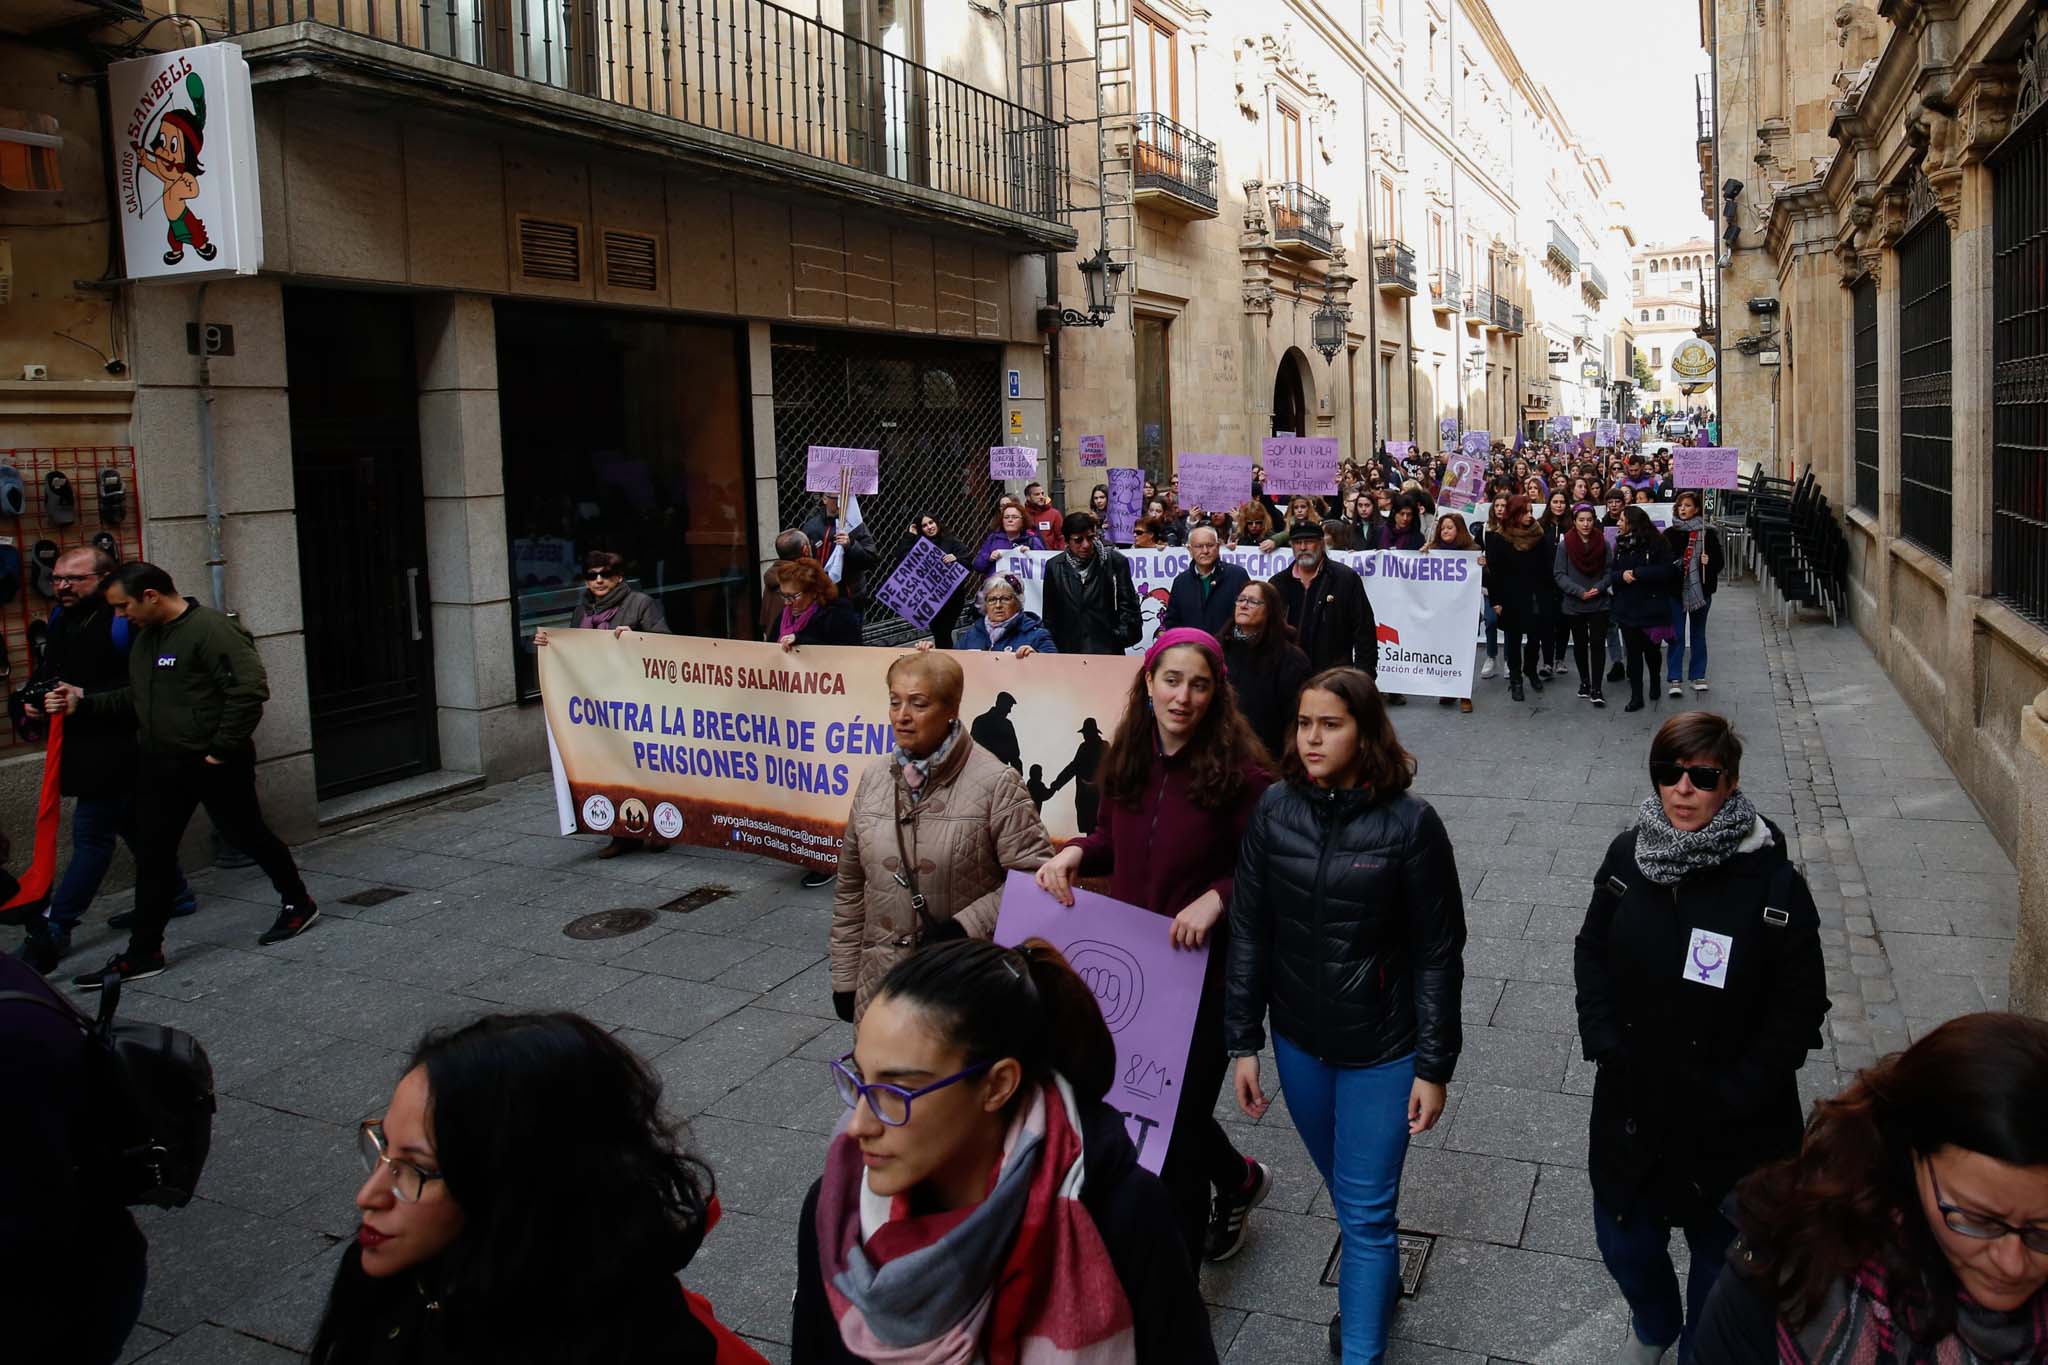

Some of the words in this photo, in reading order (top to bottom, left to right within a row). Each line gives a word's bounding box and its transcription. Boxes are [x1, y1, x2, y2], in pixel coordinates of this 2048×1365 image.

[120, 151, 138, 214] CALZADOS
[879, 584, 897, 601] DE
[893, 541, 930, 584] CAMINO
[1010, 557, 1033, 580] EN
[1154, 555, 1189, 577] LOS
[1383, 555, 1468, 581] MUJERES
[890, 600, 902, 611] A
[896, 576, 920, 604] CASA
[908, 588, 927, 611] SER
[913, 601, 935, 627] NO
[928, 563, 966, 604] VALIENTE
[158, 657, 176, 666] CNT
[1385, 647, 1452, 665] Salamanca
[1412, 666, 1424, 675] de
[1426, 667, 1462, 678] Mujeres
[643, 657, 677, 684] YAY@
[681, 661, 733, 687] GAITAS
[738, 666, 845, 695] SALAMANCA
[569, 695, 653, 733] CONTRA
[661, 705, 686, 737] LA
[693, 708, 781, 747] BRECHA
[786, 718, 815, 752] DE
[633, 741, 758, 782] PENSIONES
[765, 754, 849, 796] DIGNAS
[741, 831, 762, 846] Yayo
[763, 835, 789, 852] Gaitas
[790, 842, 838, 863] Salamanca
